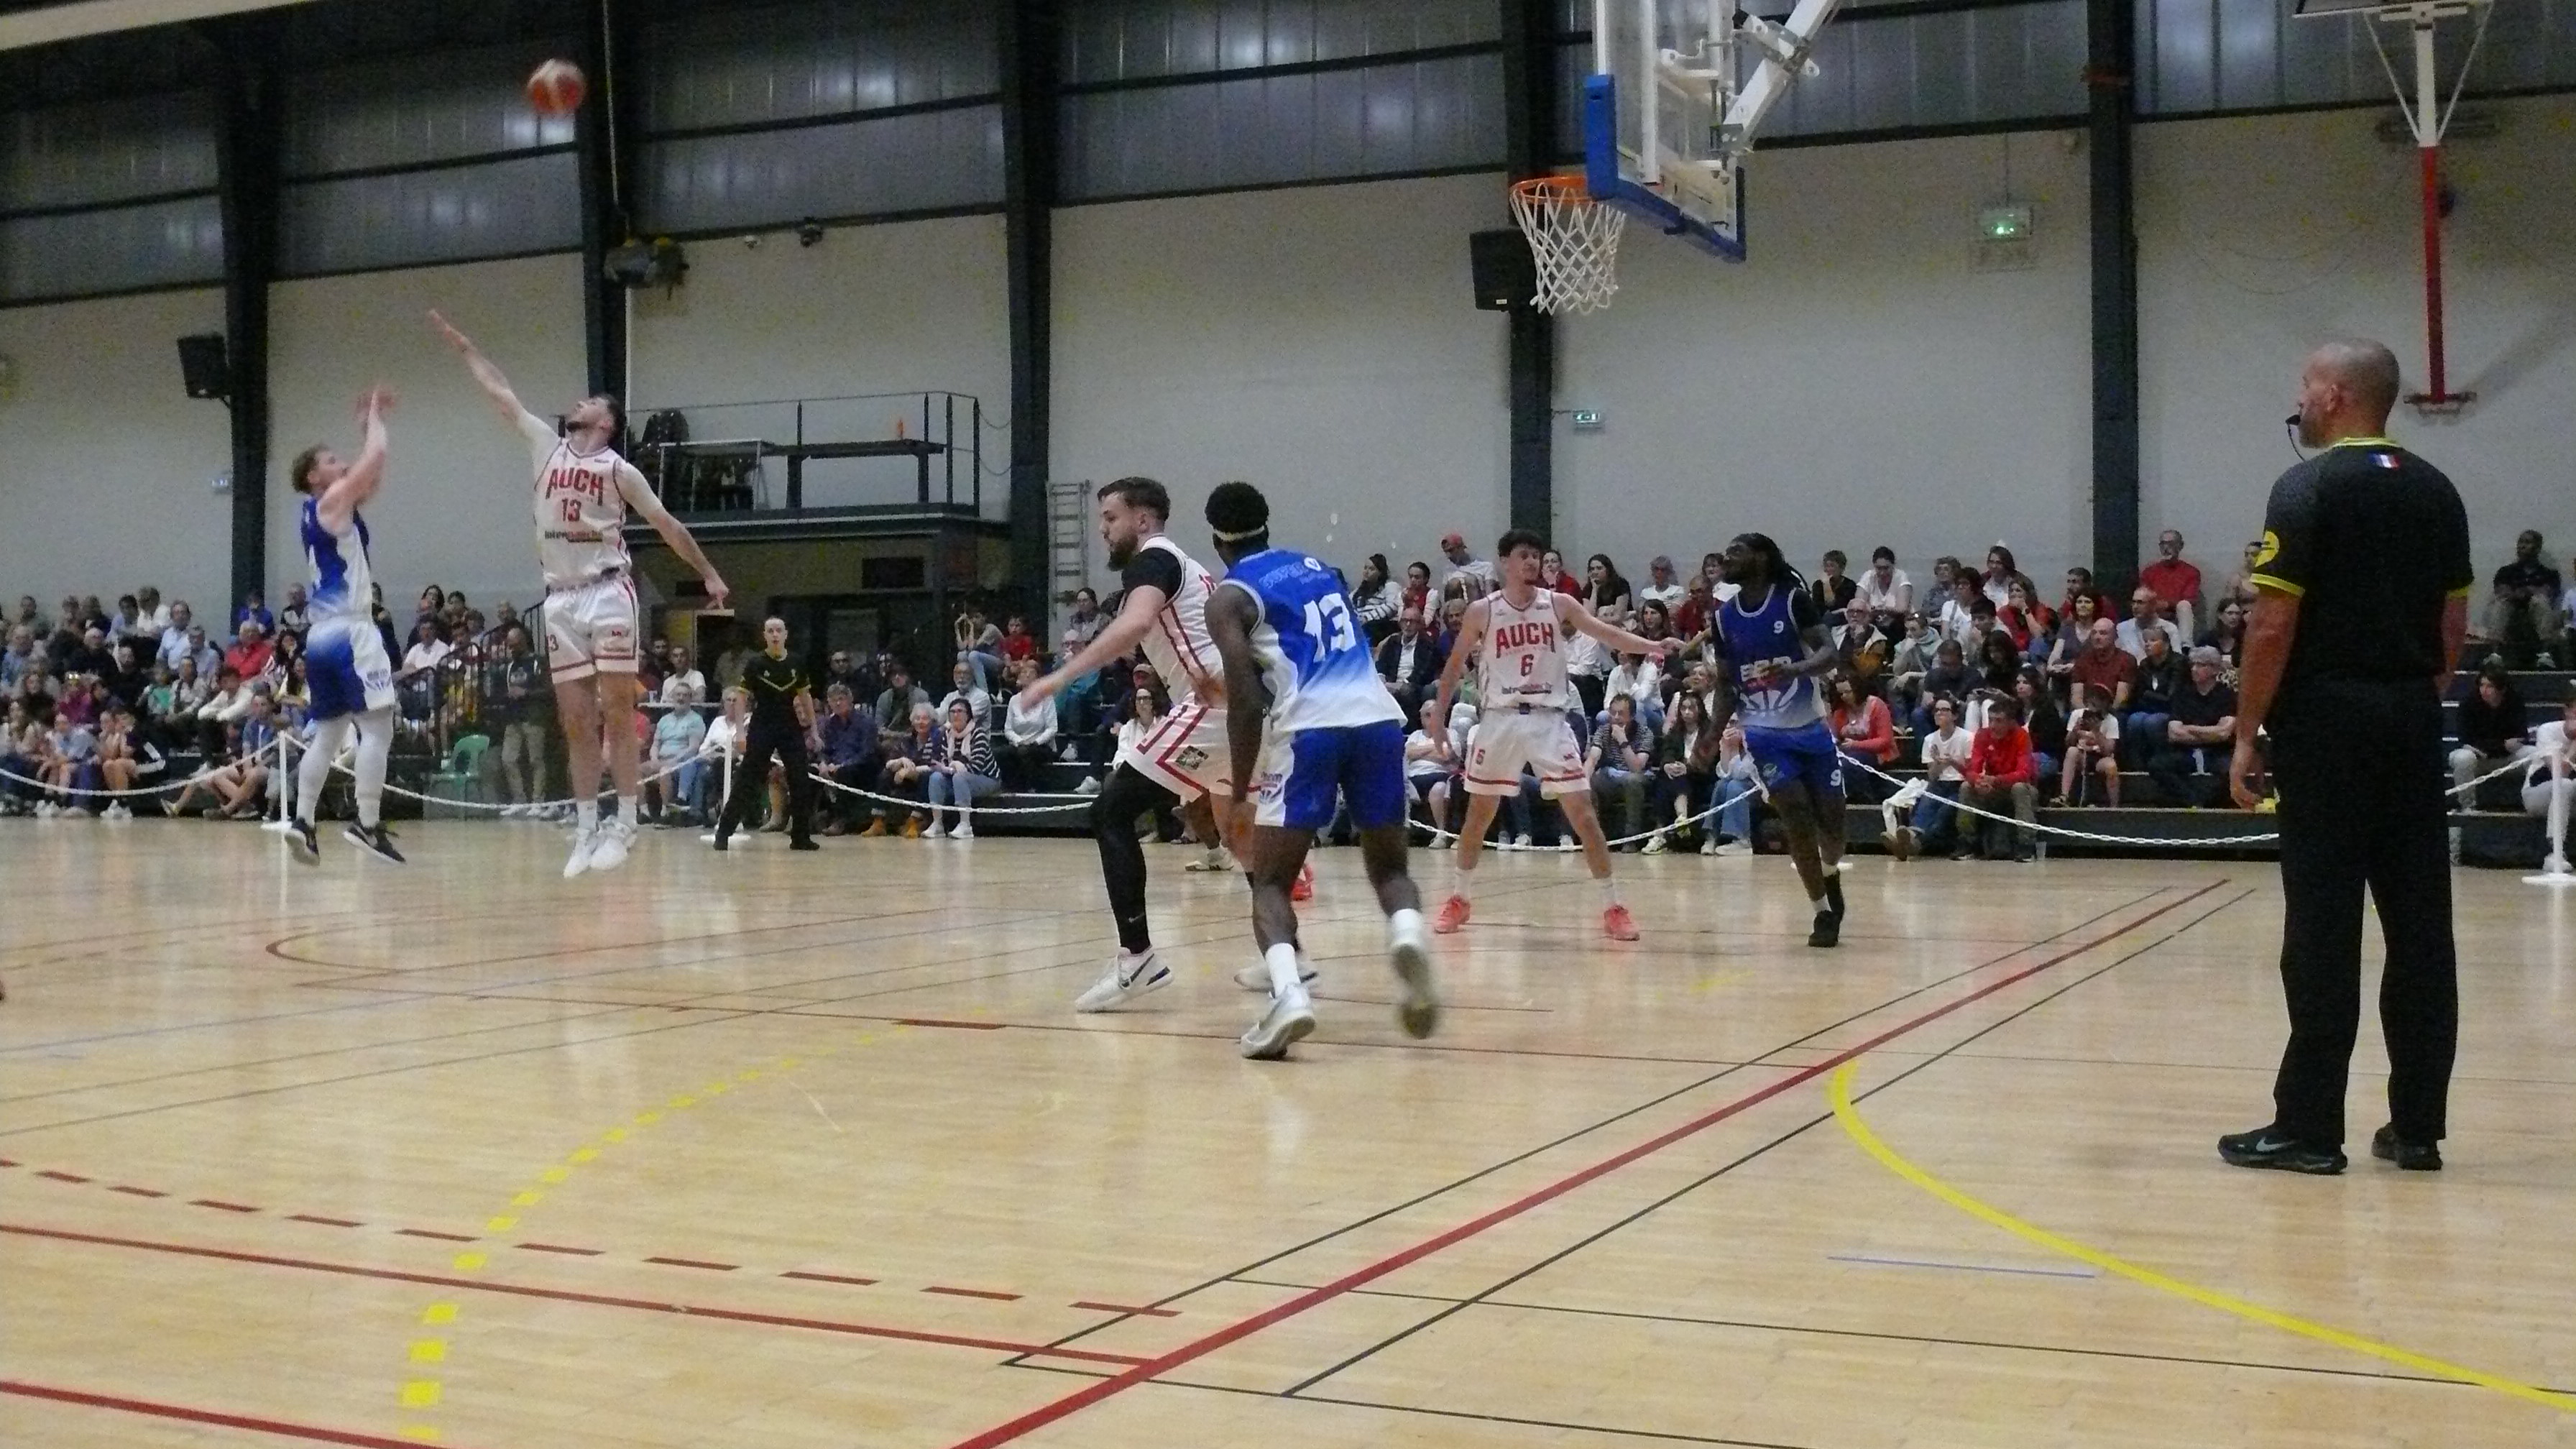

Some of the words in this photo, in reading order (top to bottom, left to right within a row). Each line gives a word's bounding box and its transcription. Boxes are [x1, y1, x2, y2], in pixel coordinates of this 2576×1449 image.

[546, 467, 604, 506] AUCH
[561, 498, 581, 522] 13
[1303, 592, 1357, 663] 13
[1773, 620, 1785, 634] 9
[1496, 622, 1556, 659] AUCH
[1520, 653, 1535, 677] 6
[1830, 768, 1841, 787] 9
